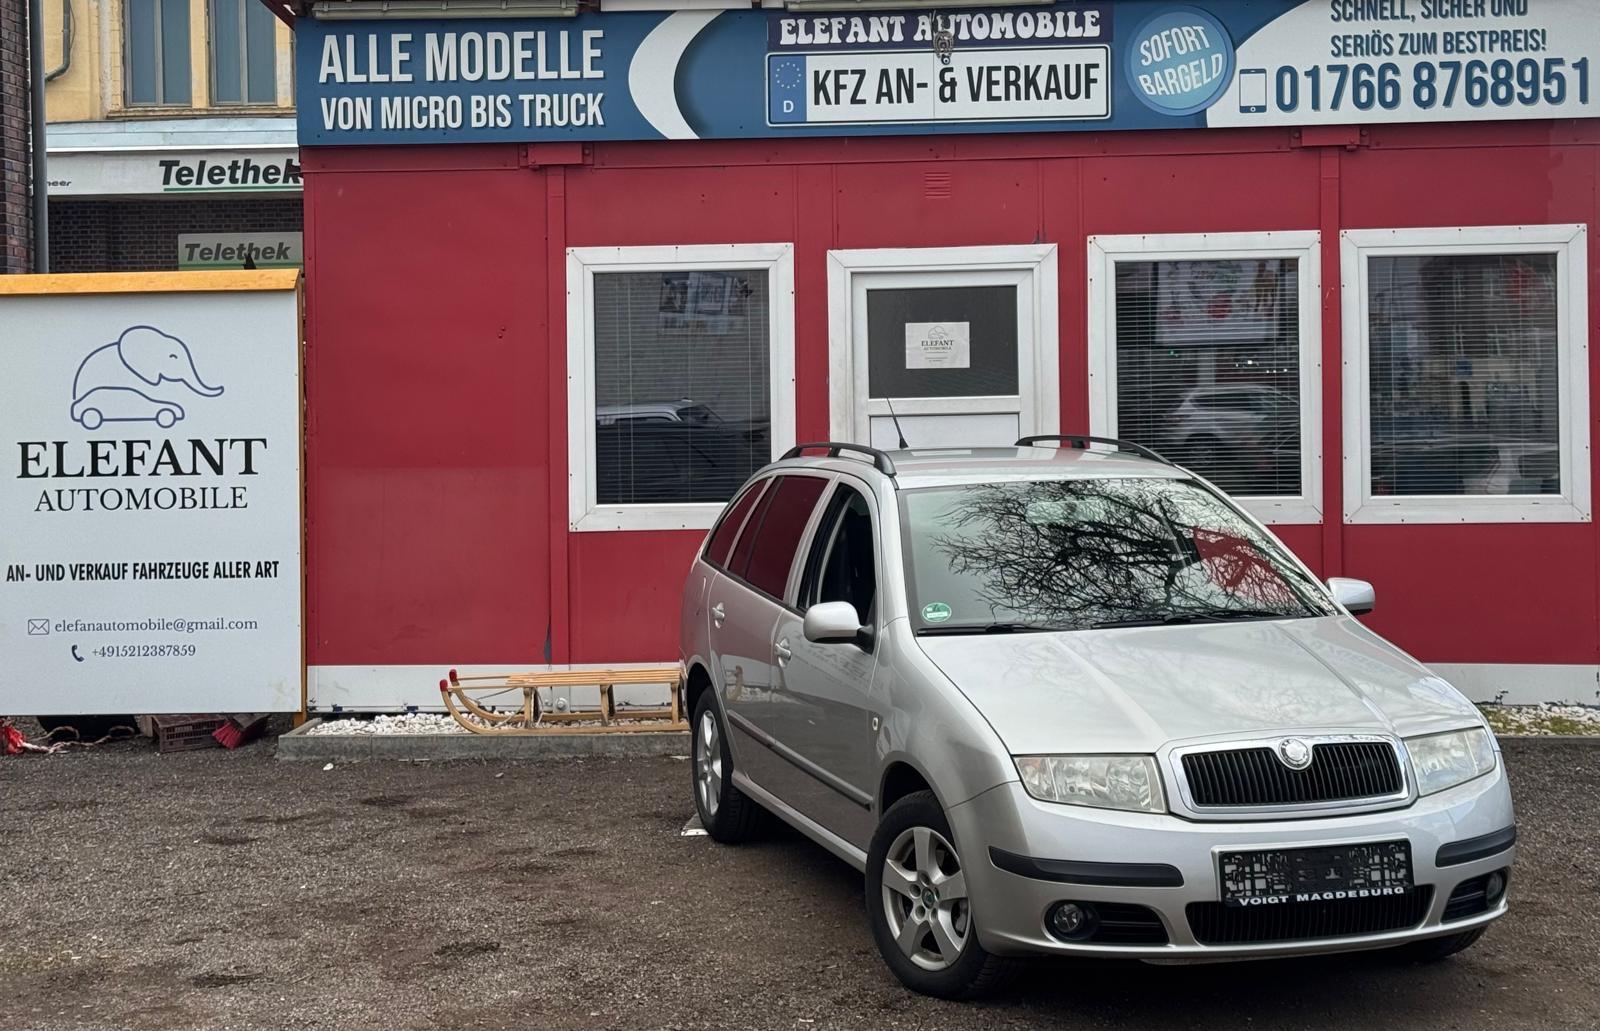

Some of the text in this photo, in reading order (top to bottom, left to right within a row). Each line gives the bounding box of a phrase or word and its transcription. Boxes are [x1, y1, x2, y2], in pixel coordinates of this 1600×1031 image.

[1331, 0, 1528, 22] SCHNELL, SICHER UND
[780, 11, 1100, 45] ELEFANT AUTOMOBILE
[319, 29, 604, 83] ALLE MODELLE
[1140, 25, 1210, 66] SOFORT
[1331, 28, 1547, 57] SERIÖS ZUM BESTPREIS!
[813, 63, 1100, 105] KFZ AN- & VERKAUF
[1138, 53, 1223, 95] BARGELD
[1276, 56, 1590, 111] 01766 8768951
[320, 93, 604, 130] VON MICRO BIS TRUCK
[783, 100, 794, 113] D
[159, 158, 301, 186] Telethek
[184, 242, 292, 262] Telethek
[16, 438, 268, 479] ELEFANT
[34, 486, 249, 512] AUTOMOBILE
[6, 560, 280, 582] AN- UND VERKAUF FAHRZEUGE ALLER ART
[54, 617, 259, 634] elefanautomobile@gmail.com
[92, 644, 197, 659] +4915212387859
[1239, 886, 1405, 907] VOIGT MAGDEBURG
